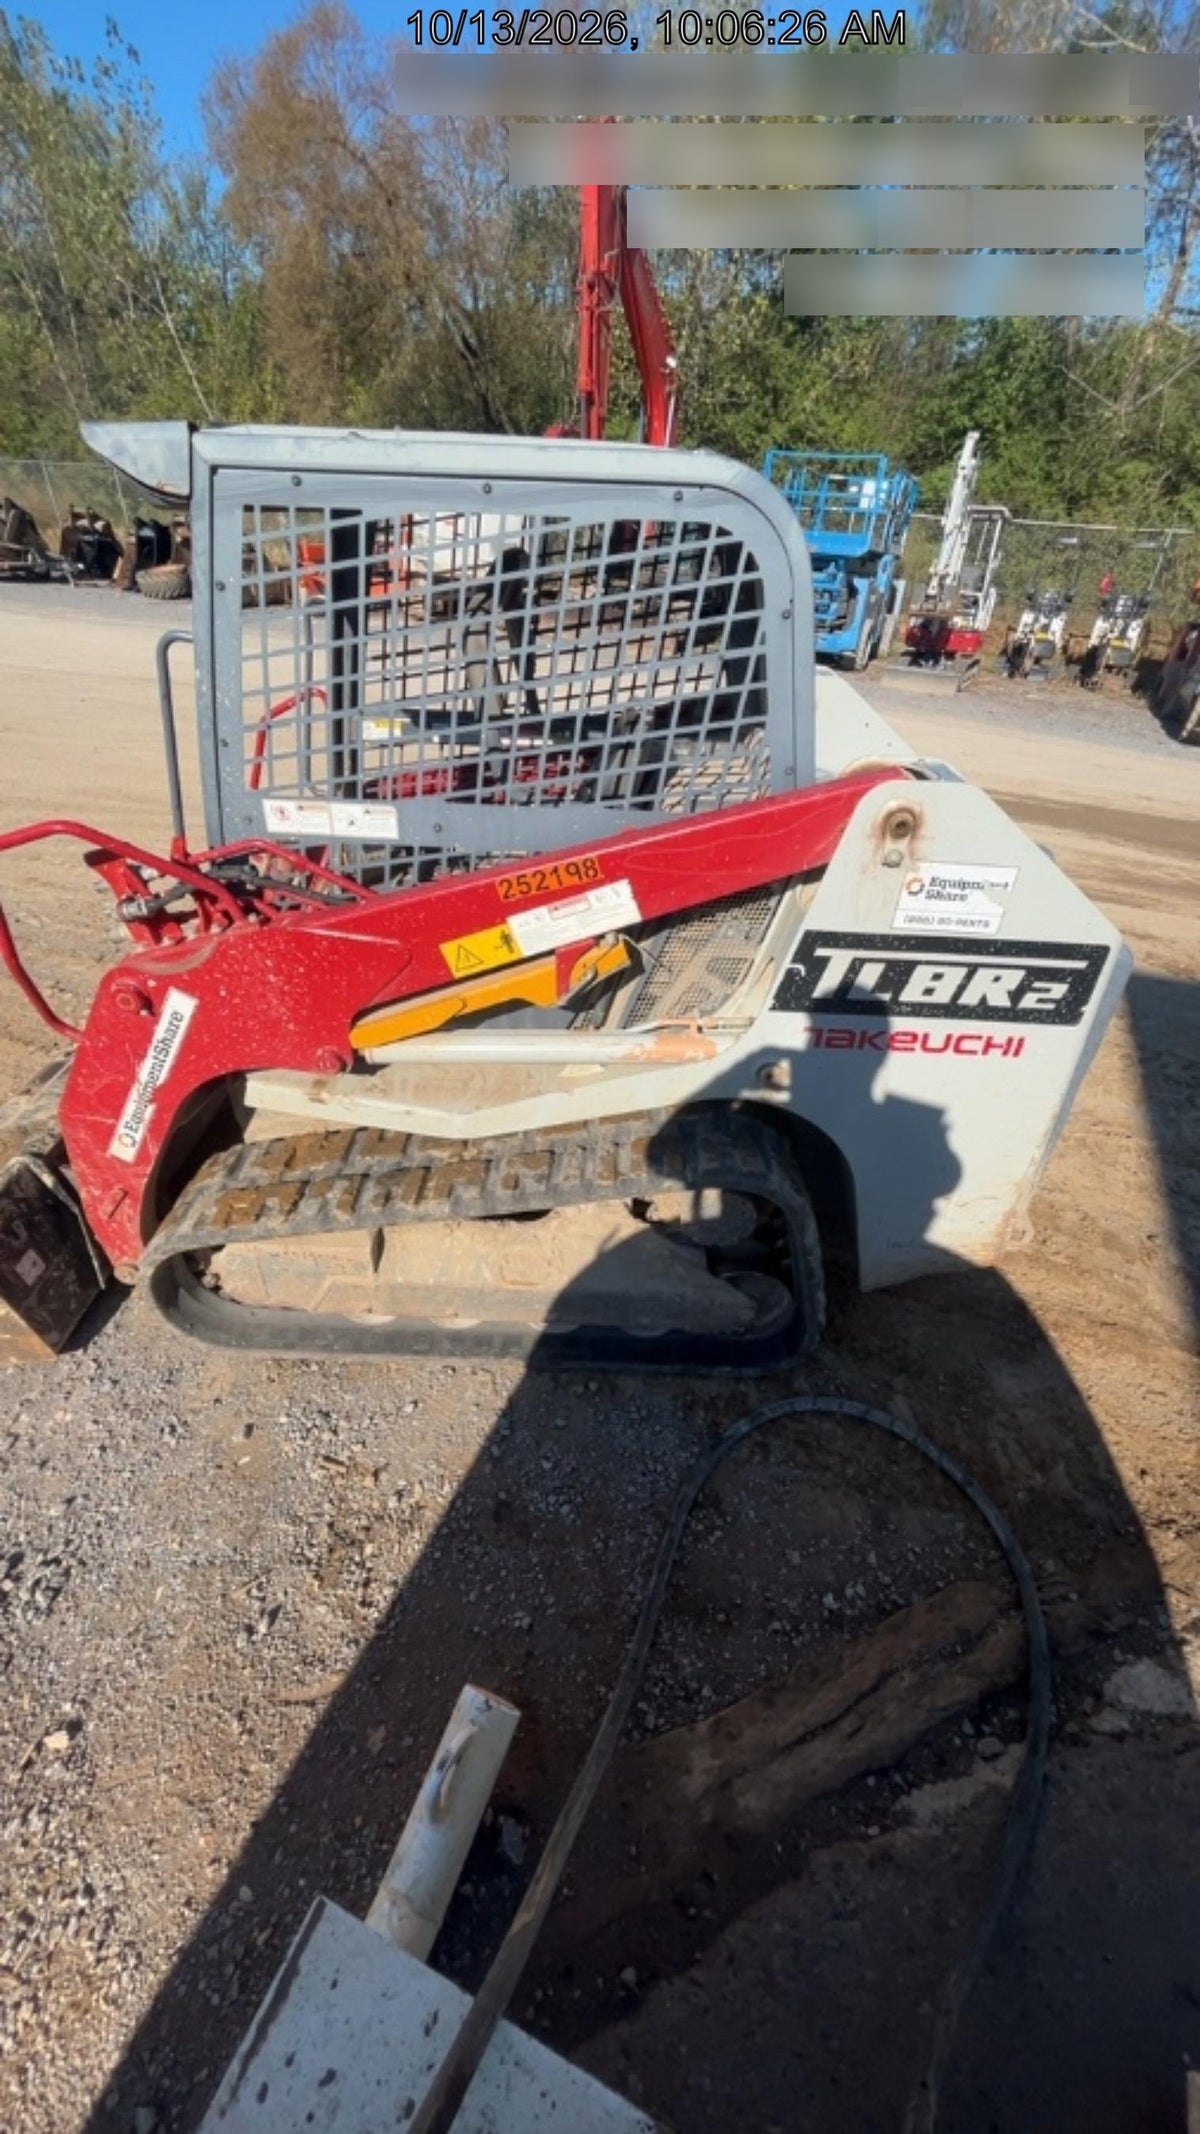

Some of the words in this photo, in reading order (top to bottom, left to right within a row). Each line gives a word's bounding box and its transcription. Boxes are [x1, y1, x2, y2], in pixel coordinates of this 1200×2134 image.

[499, 857, 599, 900] 252198
[924, 889, 969, 902] Share
[812, 947, 1090, 1011] TL8R2
